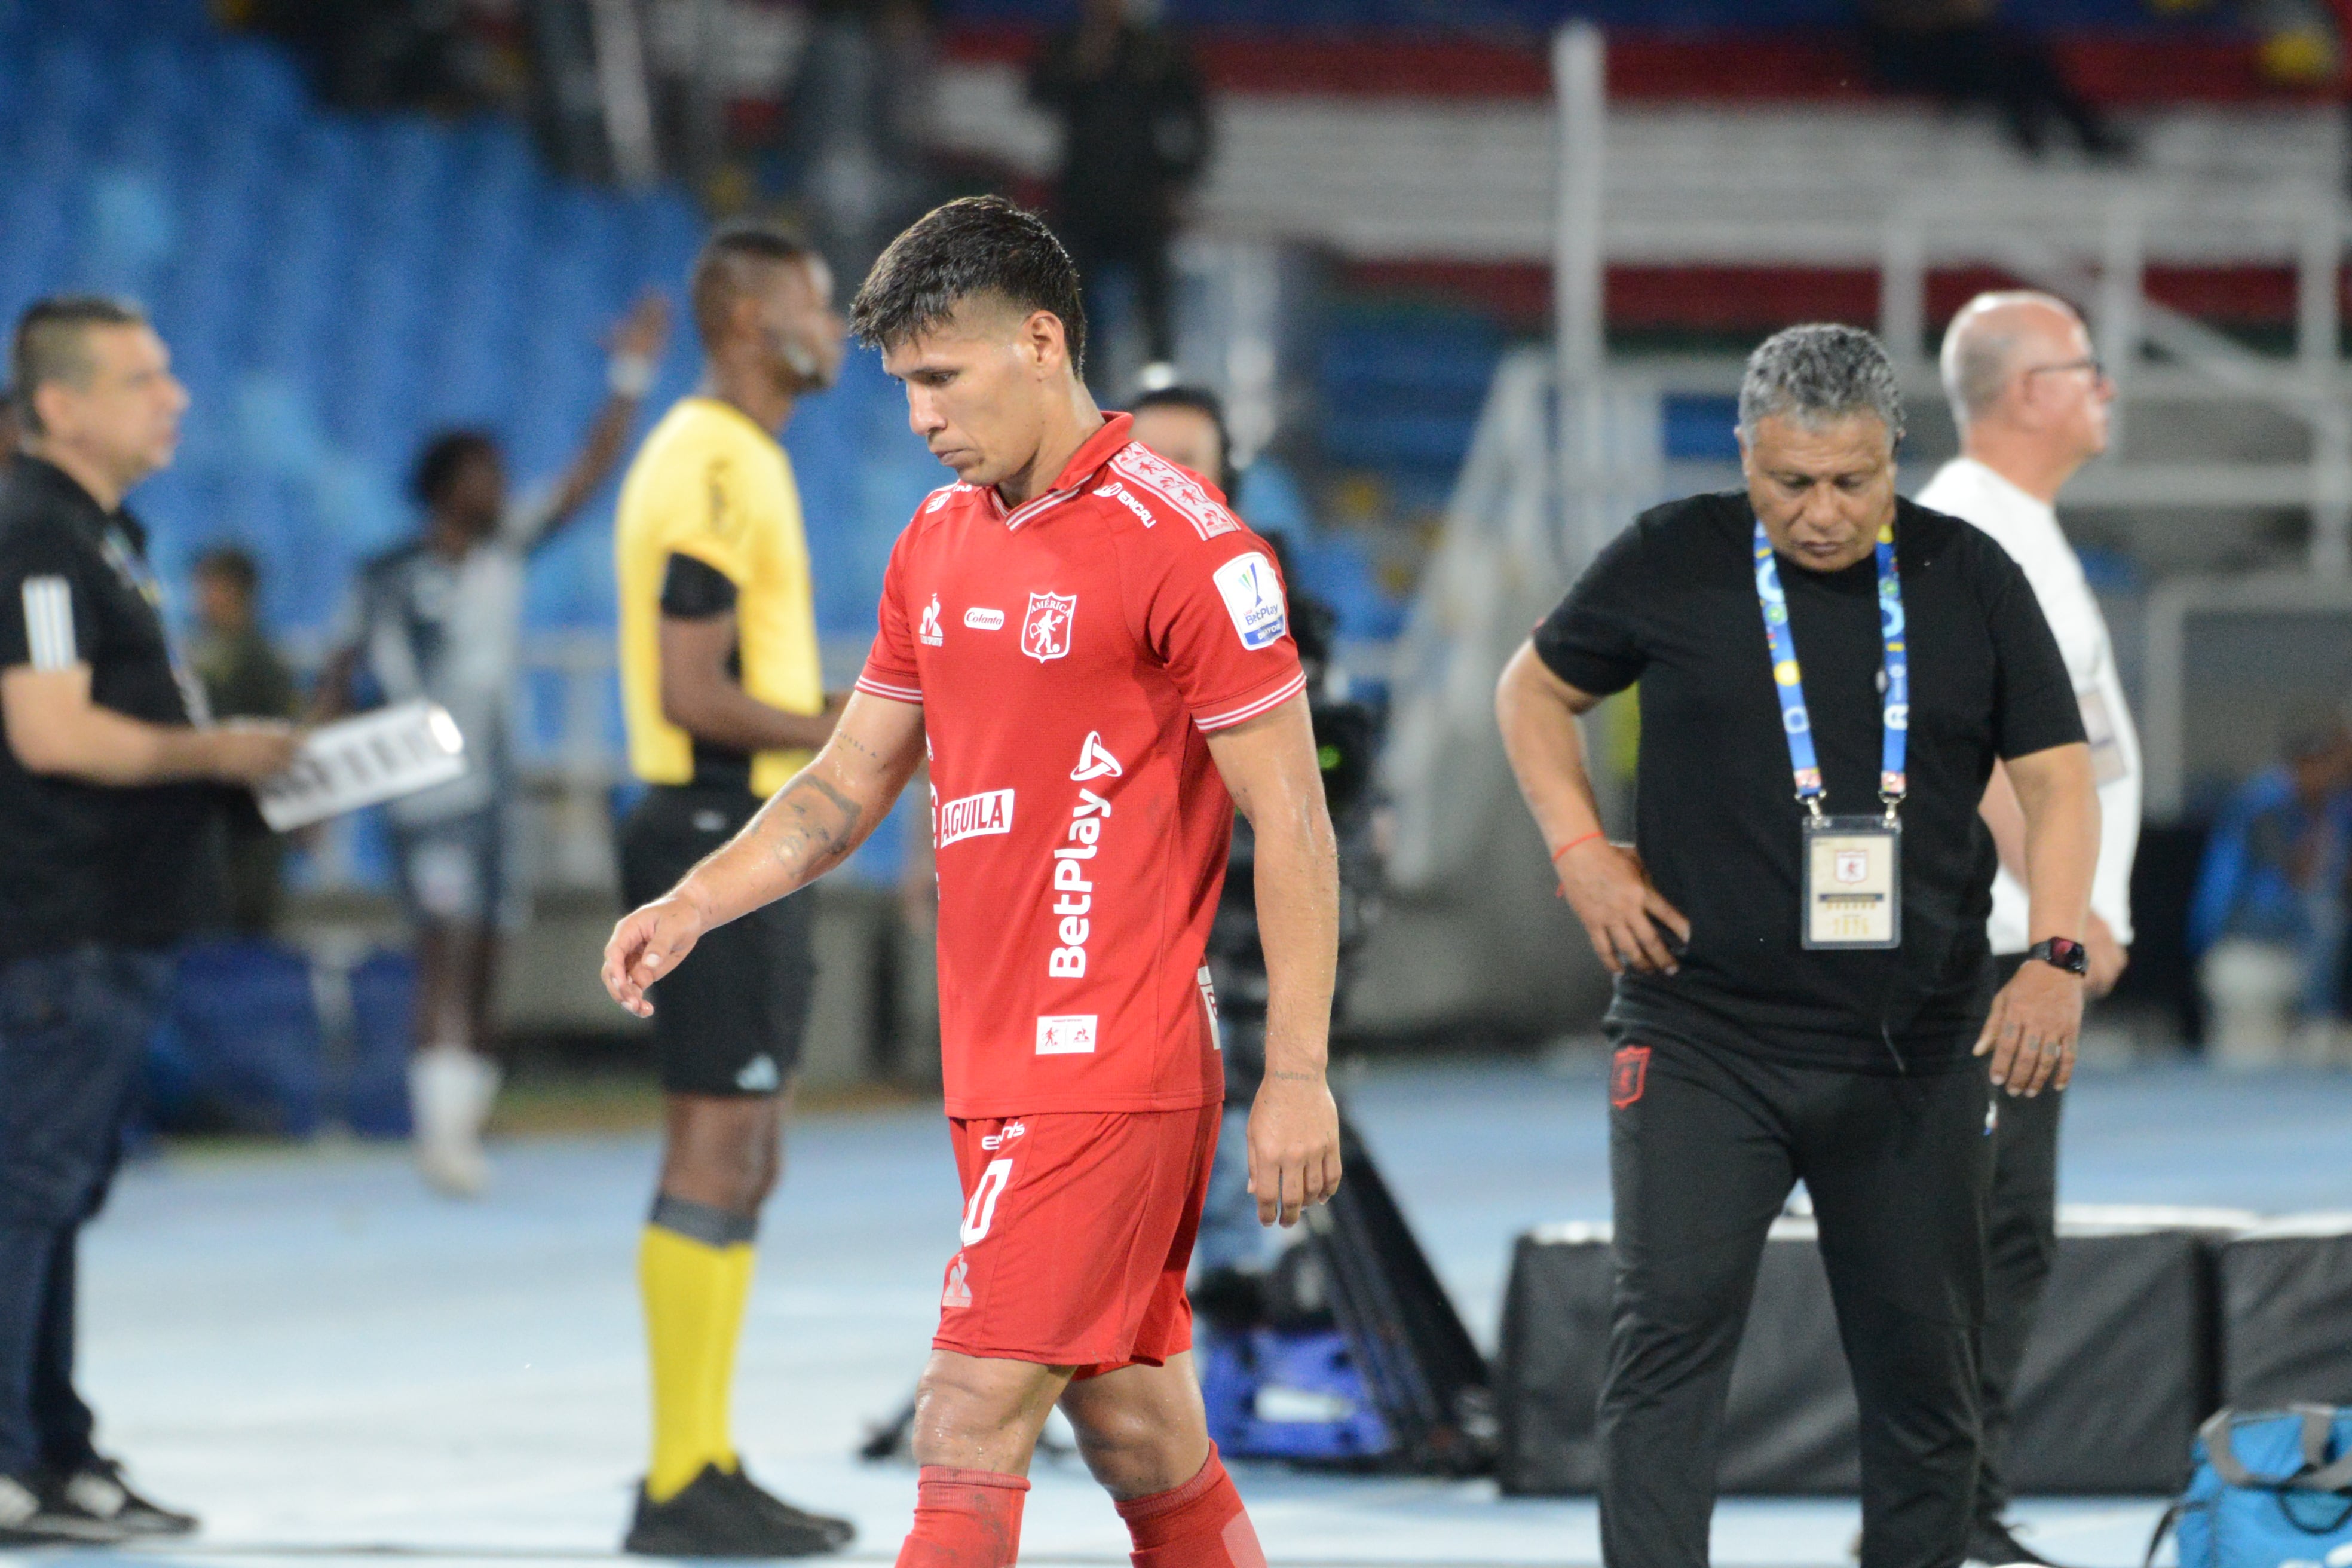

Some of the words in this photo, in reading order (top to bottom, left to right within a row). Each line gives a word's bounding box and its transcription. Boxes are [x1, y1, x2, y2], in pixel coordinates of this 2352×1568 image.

[1117, 489, 1157, 529] EMCALI
[966, 612, 1002, 626] Colanta
[1030, 598, 1071, 618] AMÉRICA
[942, 794, 1004, 843] AGUILA
[1049, 788, 1111, 979] BetPlay
